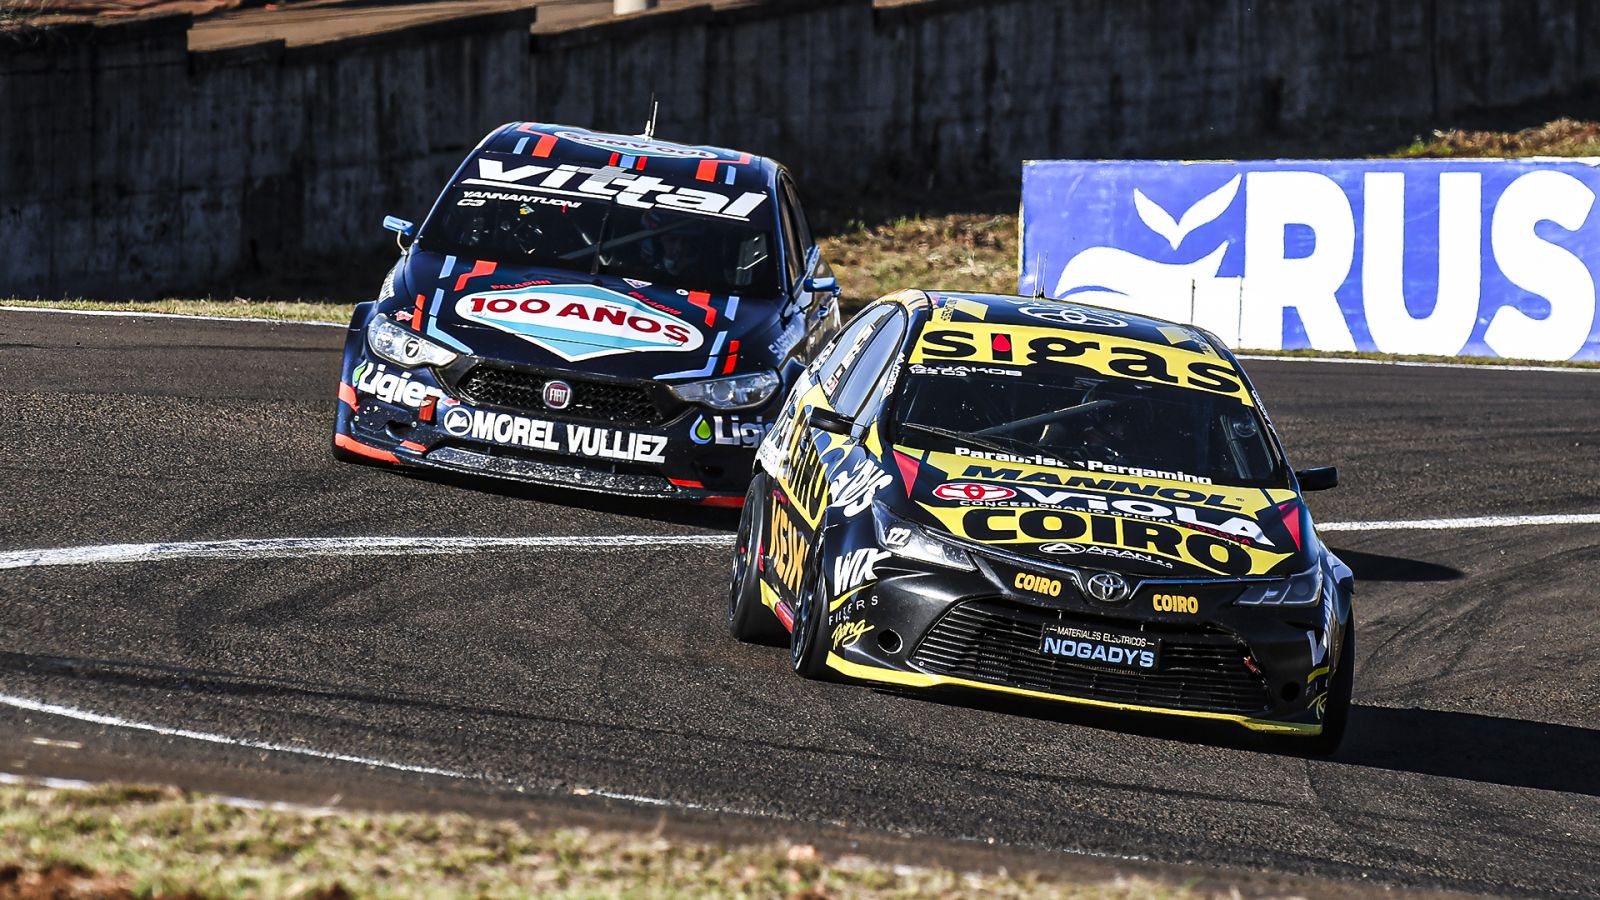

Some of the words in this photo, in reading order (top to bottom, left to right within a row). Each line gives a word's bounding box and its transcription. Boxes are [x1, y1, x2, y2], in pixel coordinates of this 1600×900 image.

[463, 191, 582, 209] YANNANTUONI
[1245, 170, 1597, 360] RUS
[470, 297, 551, 315] 100
[556, 302, 691, 344] AÑOS
[407, 343, 420, 358] 7
[921, 328, 1242, 394] sigas
[550, 388, 567, 402] FIAT
[471, 410, 560, 451] MOREL
[566, 424, 669, 464] VULLIEZ
[961, 465, 1243, 511] MANNOL
[959, 499, 1106, 515] CONCESIONARIO
[1110, 510, 1181, 526] OFICIAL
[886, 527, 912, 546] 122
[962, 508, 1253, 575] COIRO
[833, 547, 893, 597] WIX
[1014, 572, 1062, 597] COIRO
[1152, 593, 1199, 614] COIRO
[1057, 626, 1102, 641] MATERIALES
[1044, 637, 1155, 668] NOGADY'S
